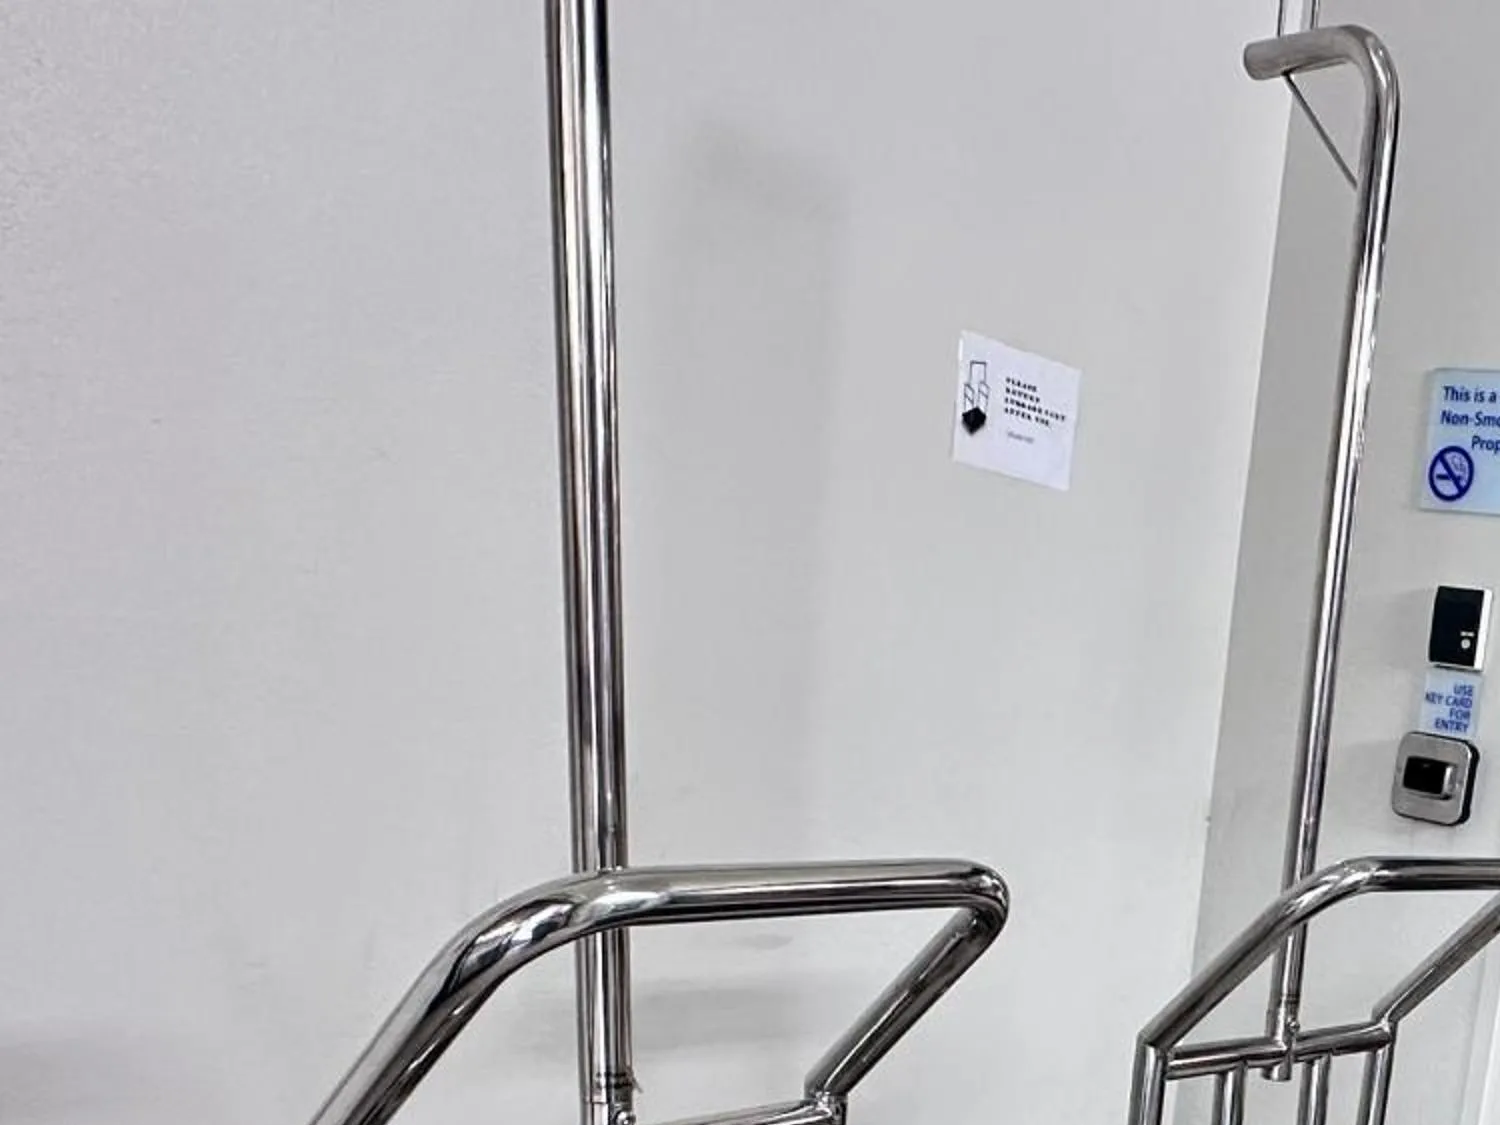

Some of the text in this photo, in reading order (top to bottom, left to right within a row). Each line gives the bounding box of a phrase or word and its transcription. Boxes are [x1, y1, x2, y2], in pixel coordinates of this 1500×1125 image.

[1443, 385, 1470, 402] This
[1474, 387, 1485, 403] is
[1488, 390, 1497, 404] a
[1453, 684, 1473, 697] USE
[1425, 691, 1472, 708] KEY CARD
[1449, 708, 1471, 720] FOR
[1434, 718, 1469, 733] ENTRY
